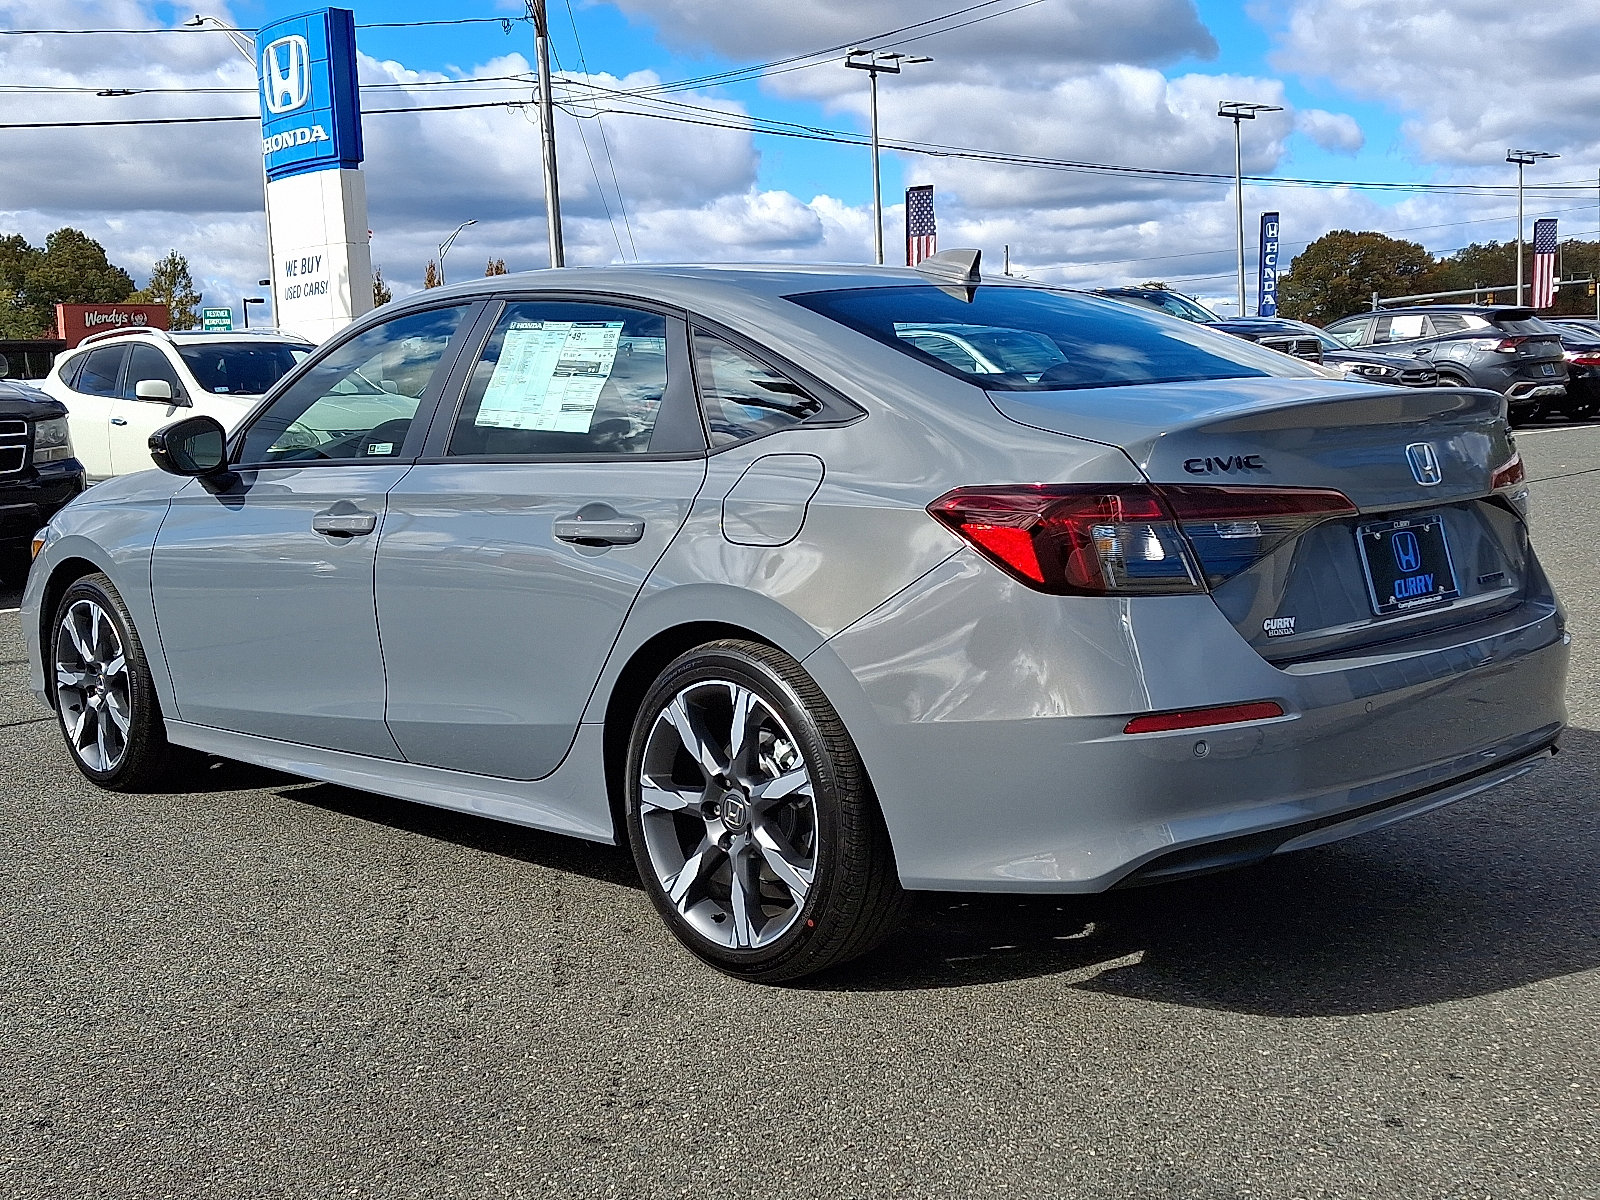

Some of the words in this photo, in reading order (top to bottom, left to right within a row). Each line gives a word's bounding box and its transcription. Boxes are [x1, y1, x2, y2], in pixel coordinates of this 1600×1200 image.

[261, 124, 330, 155] HONDA
[285, 259, 298, 277] WE
[301, 254, 322, 275] BUY
[1261, 242, 1278, 305] HONDA
[284, 284, 302, 301] USED
[303, 280, 329, 297] CARS!
[84, 308, 129, 327] Wendy's
[516, 322, 543, 330] HONDA
[1183, 454, 1264, 474] CIVIC
[1394, 573, 1434, 599] CURRY
[1263, 616, 1296, 631] CURRY
[1268, 628, 1295, 637] HONDA
